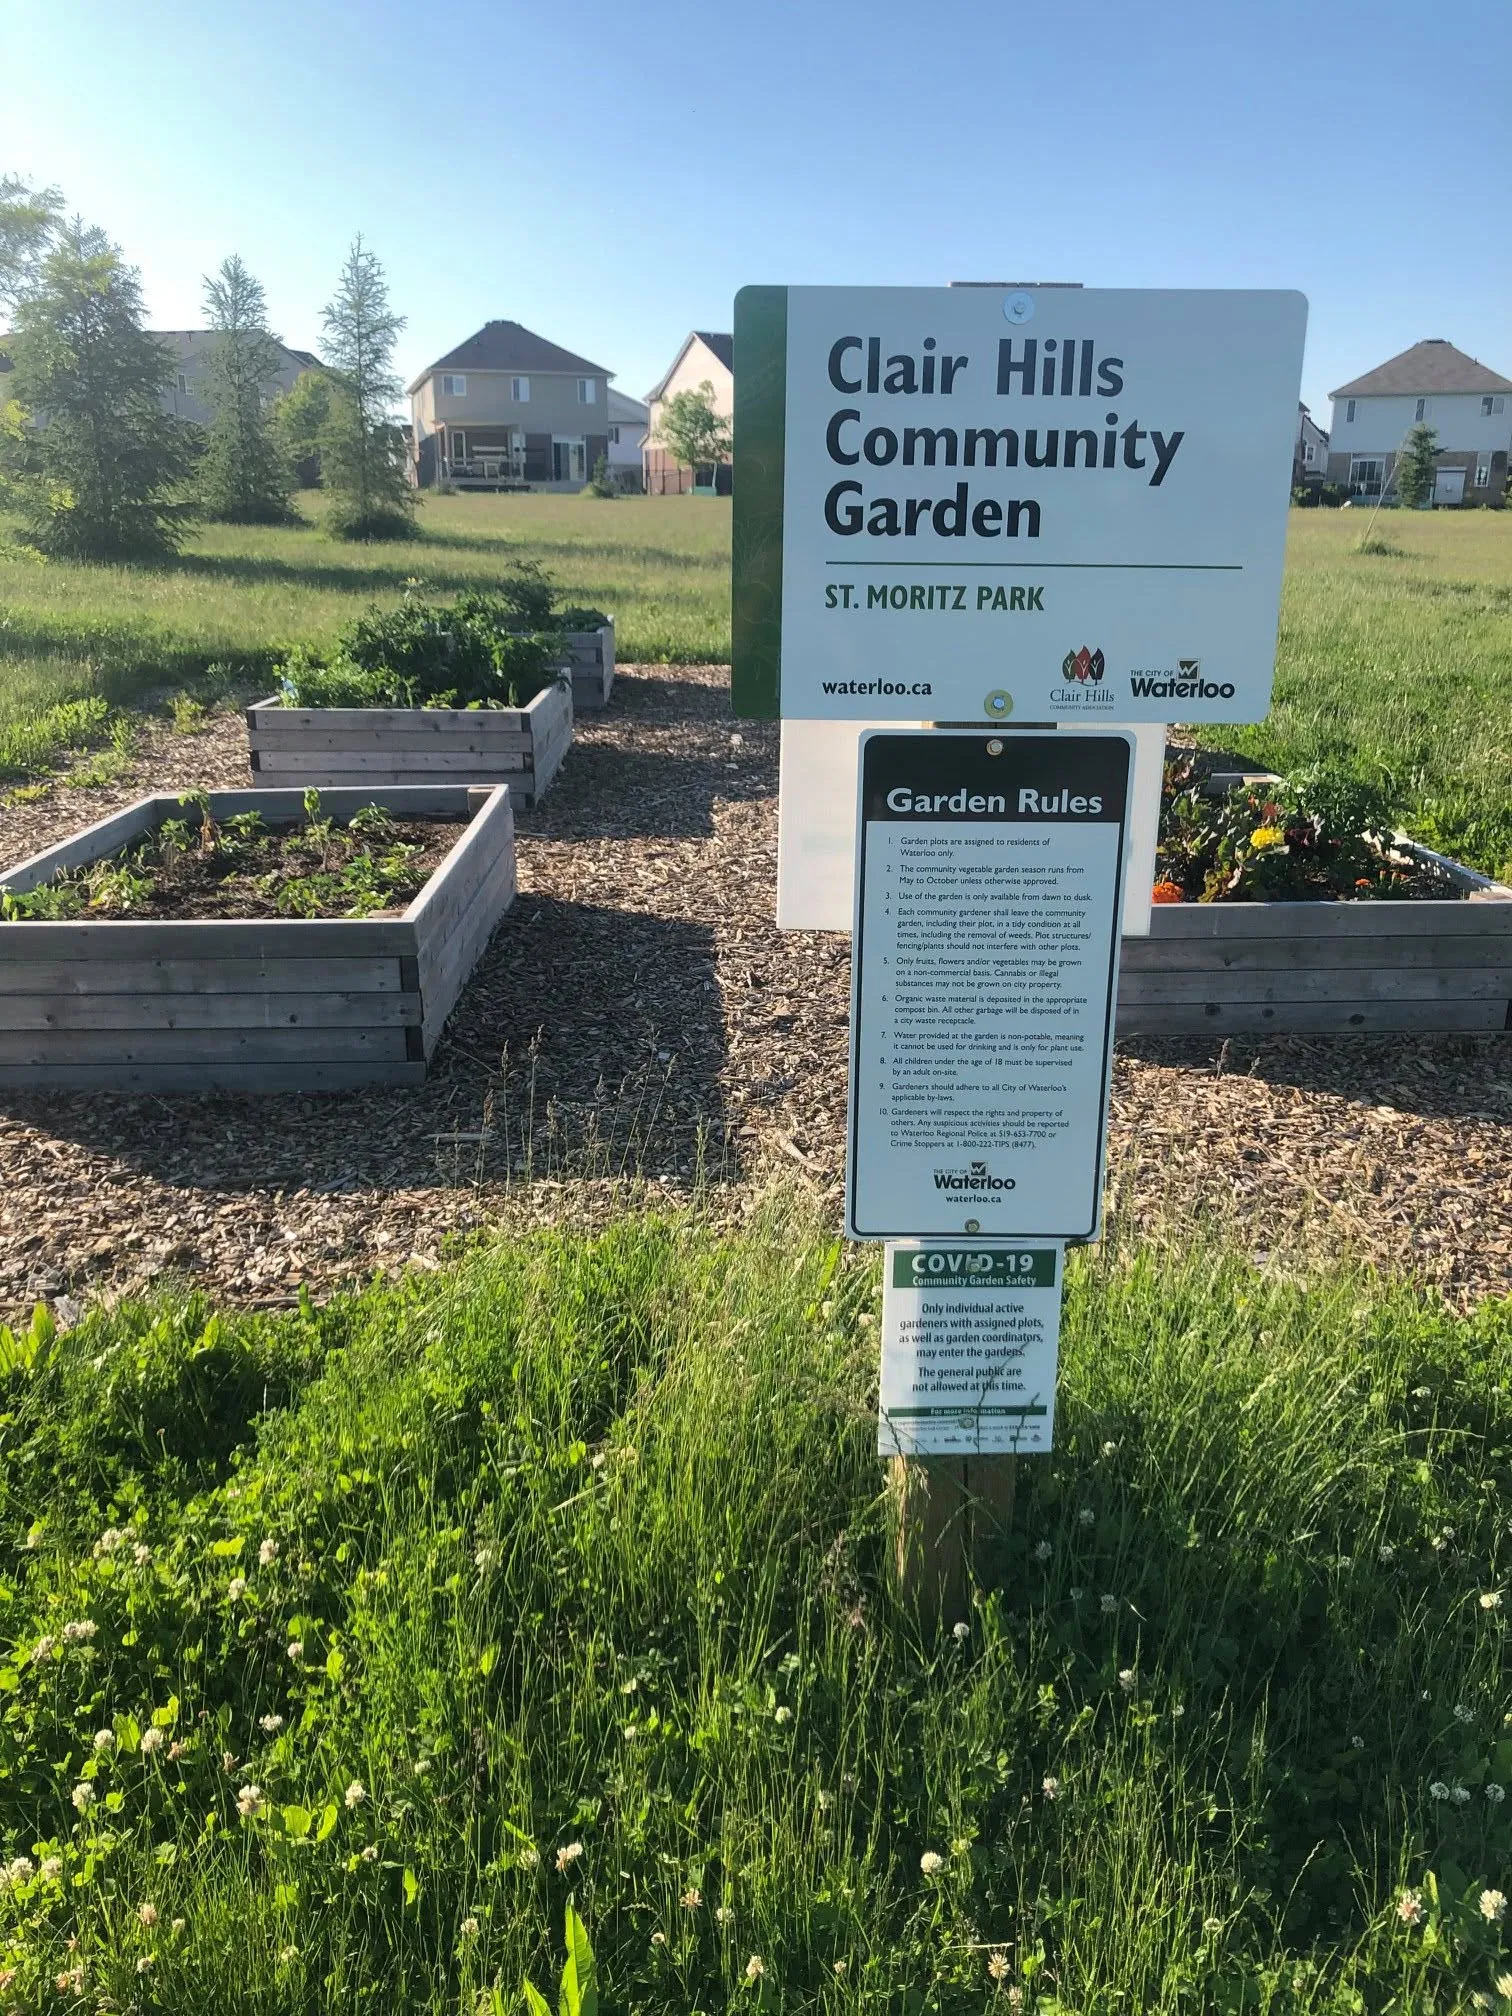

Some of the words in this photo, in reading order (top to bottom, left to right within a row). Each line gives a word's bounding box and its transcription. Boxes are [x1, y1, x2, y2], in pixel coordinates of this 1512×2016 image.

[827, 336, 969, 394] Clair
[996, 338, 1123, 397] Hills
[825, 408, 1185, 489] Community
[824, 479, 1040, 537] Garden
[825, 584, 860, 609] ST.
[867, 584, 966, 610] MORITZ
[976, 585, 1044, 611] PARK
[821, 677, 932, 695] waterloo.ca
[1130, 677, 1235, 698] Waterloo
[1049, 688, 1081, 701] Clair
[1085, 689, 1114, 702] Hills
[886, 787, 1005, 812] Garden
[1018, 788, 1102, 813] Rules
[900, 836, 928, 845] Garden
[929, 837, 948, 846] plots
[964, 837, 994, 847] assigned
[1006, 837, 1039, 846] residents
[1041, 837, 1050, 845] of
[900, 848, 935, 856] Waterloo
[937, 848, 955, 858] only.
[886, 864, 894, 872] 2.
[899, 864, 914, 872] The
[915, 865, 956, 874] community
[958, 865, 992, 874] vegetable
[993, 865, 1019, 875] garden
[1066, 865, 1084, 873] from
[899, 876, 914, 885] May
[926, 876, 958, 884] October
[960, 876, 982, 884] unless
[984, 876, 1021, 884] otherwise
[1022, 877, 1059, 886] approved.
[885, 891, 893, 899] 3.
[898, 891, 912, 899] Use
[914, 891, 922, 899] of
[937, 892, 962, 902] garden
[964, 892, 970, 900] is
[972, 892, 988, 902] only
[989, 892, 1020, 900] available
[1021, 892, 1039, 900] from
[1041, 892, 1061, 900] dawn
[1073, 893, 1093, 901] dusk.
[918, 1031, 949, 1040] provided
[973, 1032, 998, 1041] garden
[1007, 1032, 1053, 1041] non-potable,
[1054, 1034, 1084, 1042] meaning
[926, 1042, 935, 1050] be
[937, 1042, 954, 1050] used
[955, 1042, 966, 1050] for
[968, 1043, 997, 1052] drinking
[1020, 1043, 1036, 1052] only
[1050, 1044, 1068, 1052] plant
[891, 1082, 929, 1090] Gardeners
[1001, 1083, 1016, 1092] City
[1018, 1083, 1026, 1091] of
[891, 1093, 925, 1102] applicable
[927, 1093, 955, 1102] by-laws.
[879, 1107, 889, 1115] 10.
[891, 1107, 928, 1115] Gardeners
[985, 1109, 1005, 1118] rights
[1054, 1109, 1063, 1117] of
[890, 1118, 916, 1126] others.
[917, 1118, 931, 1127] Any
[932, 1119, 968, 1127] suspicious
[969, 1119, 1000, 1127] activities
[1002, 1119, 1025, 1127] should
[1037, 1120, 1069, 1129] reported
[936, 1129, 965, 1138] Regional
[967, 1129, 988, 1137] Police
[998, 1129, 1046, 1138] 519-653-7700
[890, 1139, 912, 1147] Crime
[914, 1139, 945, 1148] Stoppers
[956, 1140, 1010, 1148] 1-800-222-TIPS
[1011, 1140, 1037, 1149] (8477).
[933, 1175, 1016, 1190] Waterloo
[945, 1194, 1001, 1203] waterloo.ca
[912, 1275, 967, 1287] Community
[969, 1274, 1003, 1285] Garden
[1005, 1274, 1036, 1287] Safety
[922, 1303, 943, 1315] Only
[945, 1302, 993, 1313] individual
[995, 1302, 1024, 1313] active
[899, 1317, 948, 1330] gardeners
[949, 1317, 972, 1328] with
[974, 1317, 1016, 1330] assigned
[1017, 1317, 1045, 1330] plots,
[898, 1334, 909, 1343] as
[911, 1332, 931, 1343] well
[933, 1334, 943, 1343] as
[945, 1332, 979, 1344] garden
[981, 1332, 1044, 1344] coordinators,
[916, 1349, 937, 1359] may
[938, 1348, 964, 1357] enter
[966, 1347, 982, 1356] the
[984, 1347, 1026, 1359] gardens.
[919, 1367, 935, 1377] The
[937, 1366, 973, 1379] general
[975, 1366, 1004, 1379] public
[1006, 1368, 1021, 1376] are
[912, 1382, 928, 1392] not
[930, 1381, 968, 1391] allowed
[969, 1382, 979, 1390] at
[982, 1381, 999, 1392] this
[1001, 1381, 1027, 1390] time.
